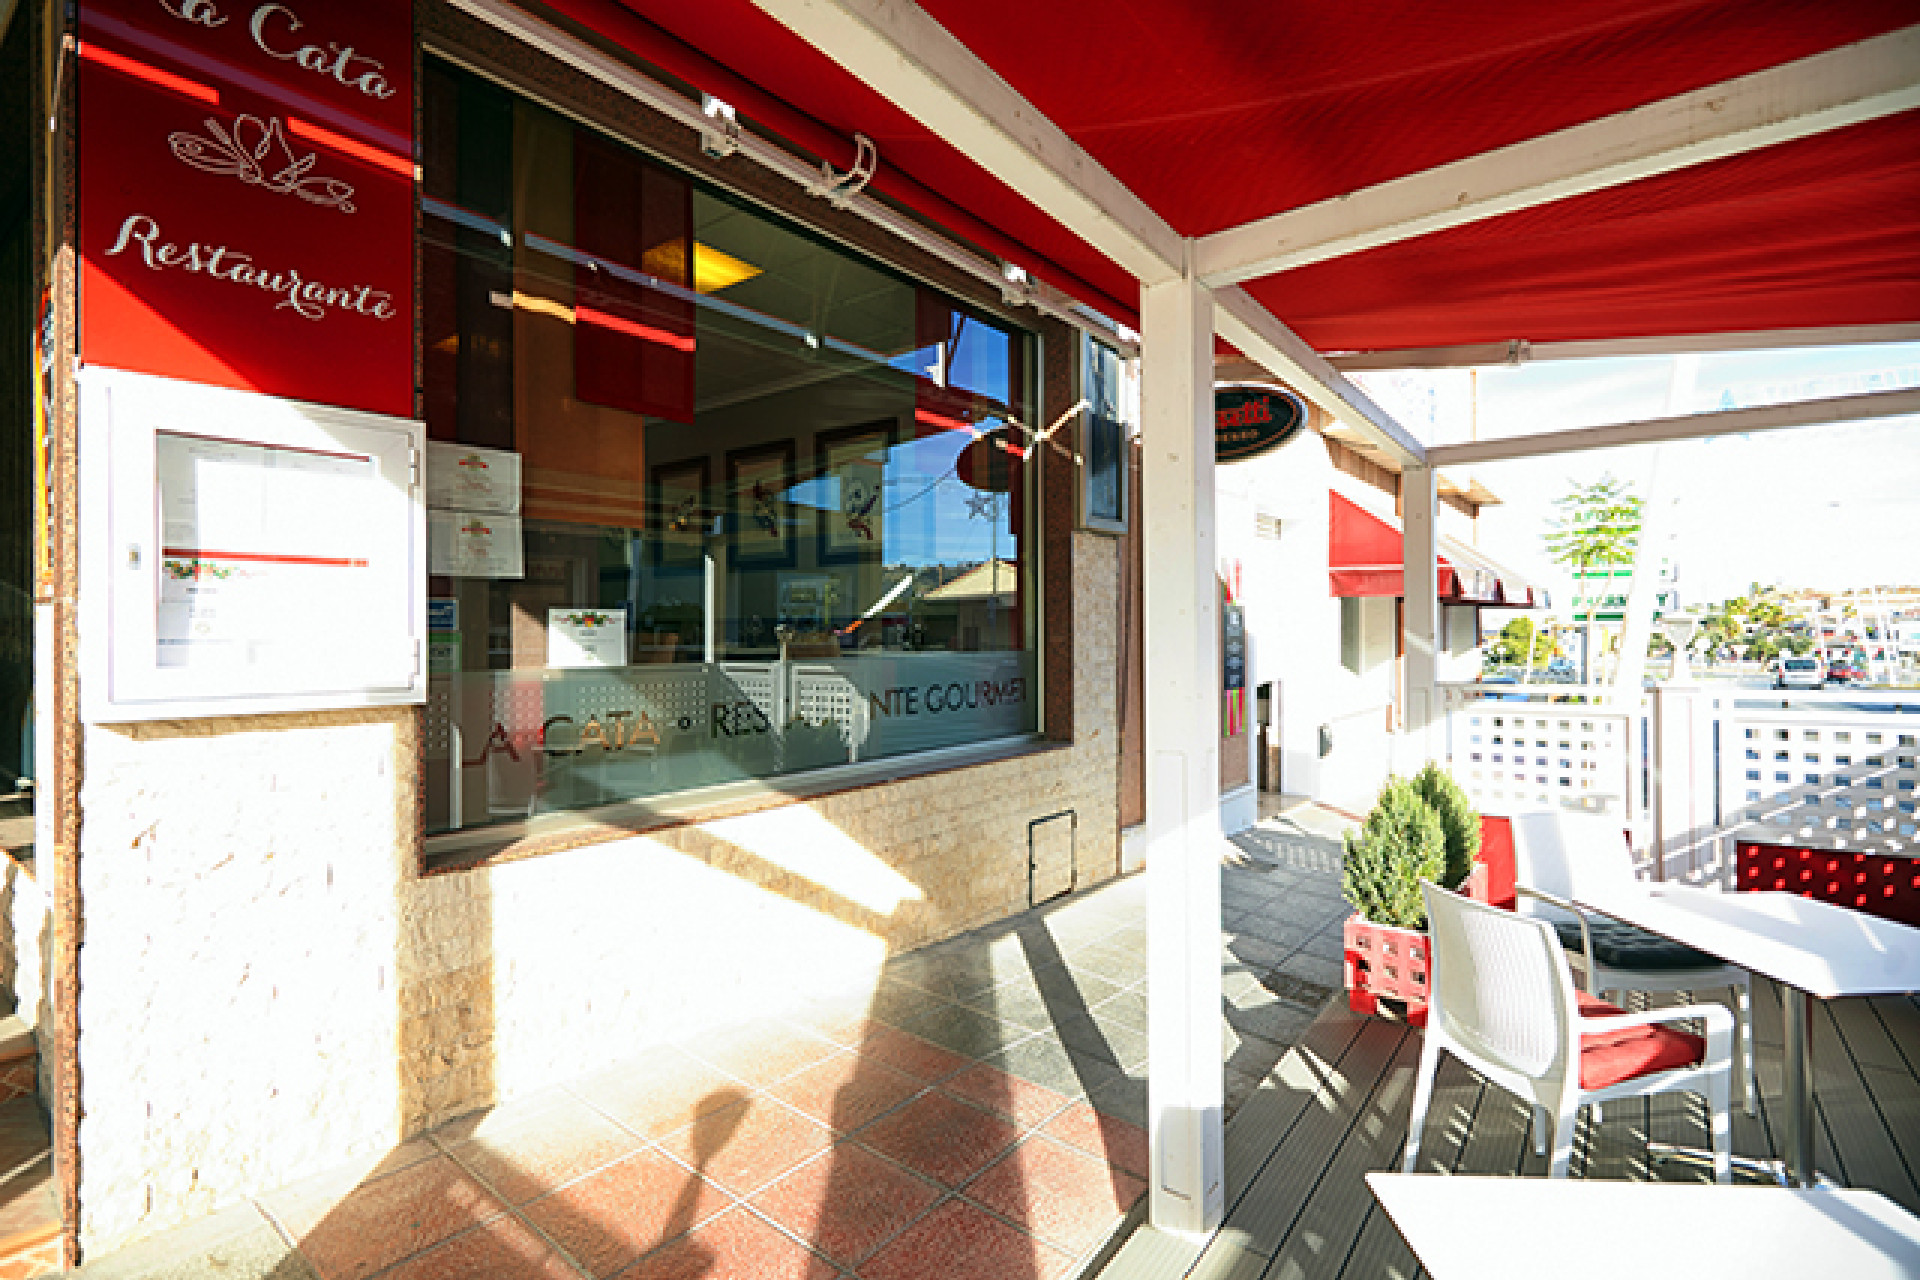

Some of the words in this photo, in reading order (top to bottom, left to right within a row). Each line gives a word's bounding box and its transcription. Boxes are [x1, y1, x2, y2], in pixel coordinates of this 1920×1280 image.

[159, 0, 228, 27] a
[249, 4, 396, 99] Cata
[104, 213, 396, 320] Restaurante
[537, 710, 661, 757] CATA
